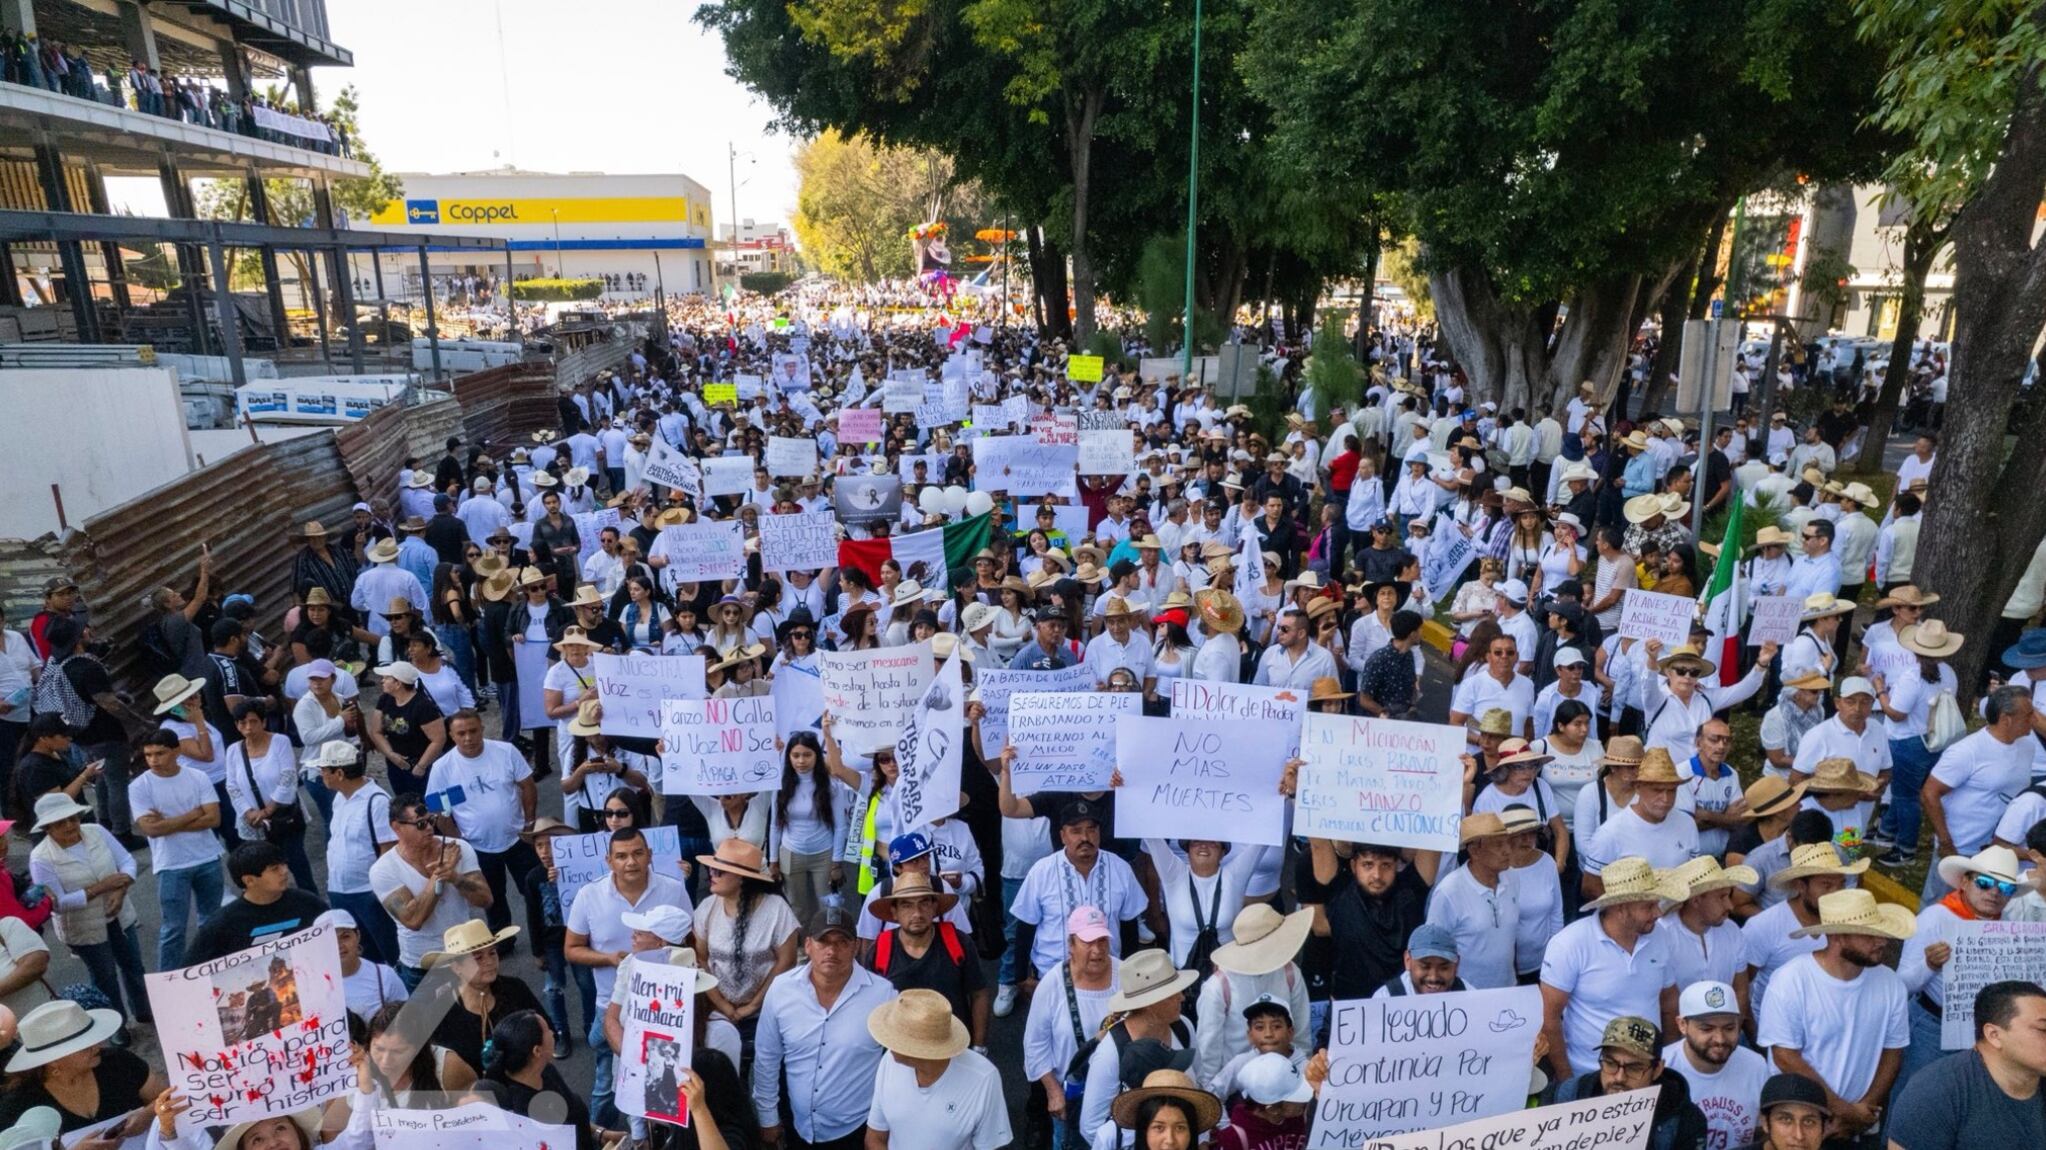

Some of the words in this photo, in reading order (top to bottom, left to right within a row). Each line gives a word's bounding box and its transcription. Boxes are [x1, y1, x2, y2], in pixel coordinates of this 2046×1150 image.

[449, 203, 519, 224] Coppel
[820, 651, 844, 672] Amo
[846, 659, 867, 672] ser
[871, 672, 901, 690] hasta
[907, 671, 918, 687] la
[980, 671, 996, 685] YA
[1000, 671, 1032, 685] BASTA
[1035, 671, 1049, 684] DE
[663, 700, 703, 726] Manzo
[706, 698, 728, 726] NO
[732, 698, 774, 725] Calla
[857, 694, 872, 711] de
[879, 691, 890, 709] la
[1012, 695, 1082, 712] SEGUIREMOS
[1087, 695, 1105, 710] DE
[1110, 695, 1129, 711] PIE
[1171, 681, 1188, 709] El
[1193, 684, 1236, 714] Dolor
[1240, 698, 1260, 719] de
[1261, 699, 1297, 722] Perder
[1011, 714, 1093, 729] TRABAJANDO
[687, 732, 719, 755] Voz
[721, 727, 743, 753] NO
[1091, 730, 1107, 741] AL
[1173, 731, 1222, 755] NO
[1035, 761, 1053, 771] UN
[1169, 755, 1231, 778] MAS
[1387, 751, 1438, 771] BRAVO
[1151, 783, 1254, 814] MUERTES
[1359, 791, 1423, 812] MANZO
[581, 834, 599, 858] El
[556, 865, 593, 884] Tiene
[183, 953, 252, 982] Carlos
[261, 927, 323, 956] Manzo
[664, 982, 684, 1001] mi
[634, 999, 686, 1029] hablará
[1336, 1004, 1366, 1046] El
[1381, 1000, 1469, 1045] legado
[176, 1042, 269, 1073] Nació
[284, 1015, 347, 1059] para
[290, 1056, 354, 1092] para
[1458, 1049, 1494, 1077] Por
[186, 1070, 239, 1092] ser
[189, 1104, 240, 1125] ser
[265, 1072, 359, 1113] historia
[1322, 1096, 1419, 1123] Uruapan
[1450, 1090, 1486, 1116] Por
[1702, 1095, 1744, 1117] RAUSS
[375, 1110, 392, 1128] El
[398, 1118, 428, 1131] mejor
[1530, 1116, 1563, 1148] ya
[1569, 1107, 1598, 1126] no
